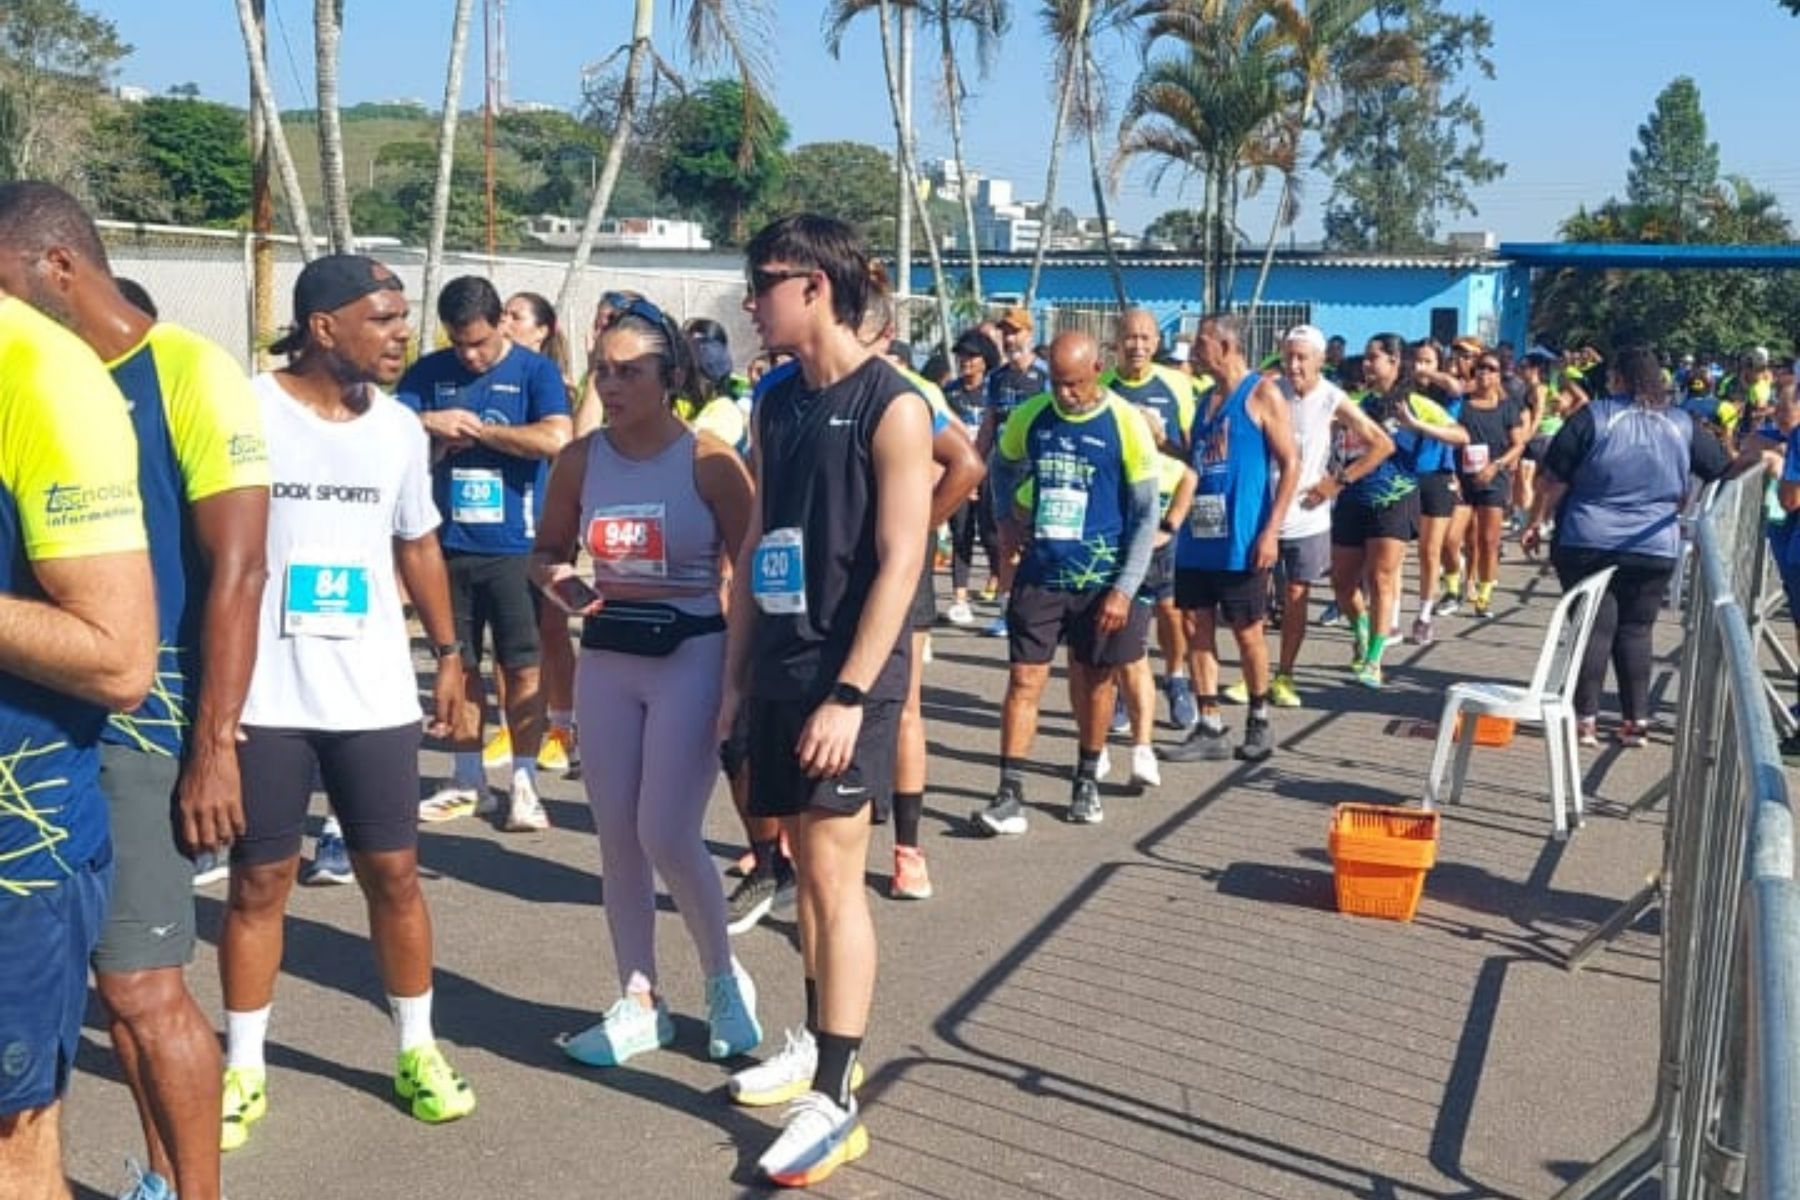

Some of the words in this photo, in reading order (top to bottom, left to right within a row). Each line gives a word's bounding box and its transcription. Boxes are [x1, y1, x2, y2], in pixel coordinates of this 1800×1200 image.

[316, 484, 381, 503] SPORTS
[762, 551, 789, 578] 420
[315, 569, 349, 598] 84
